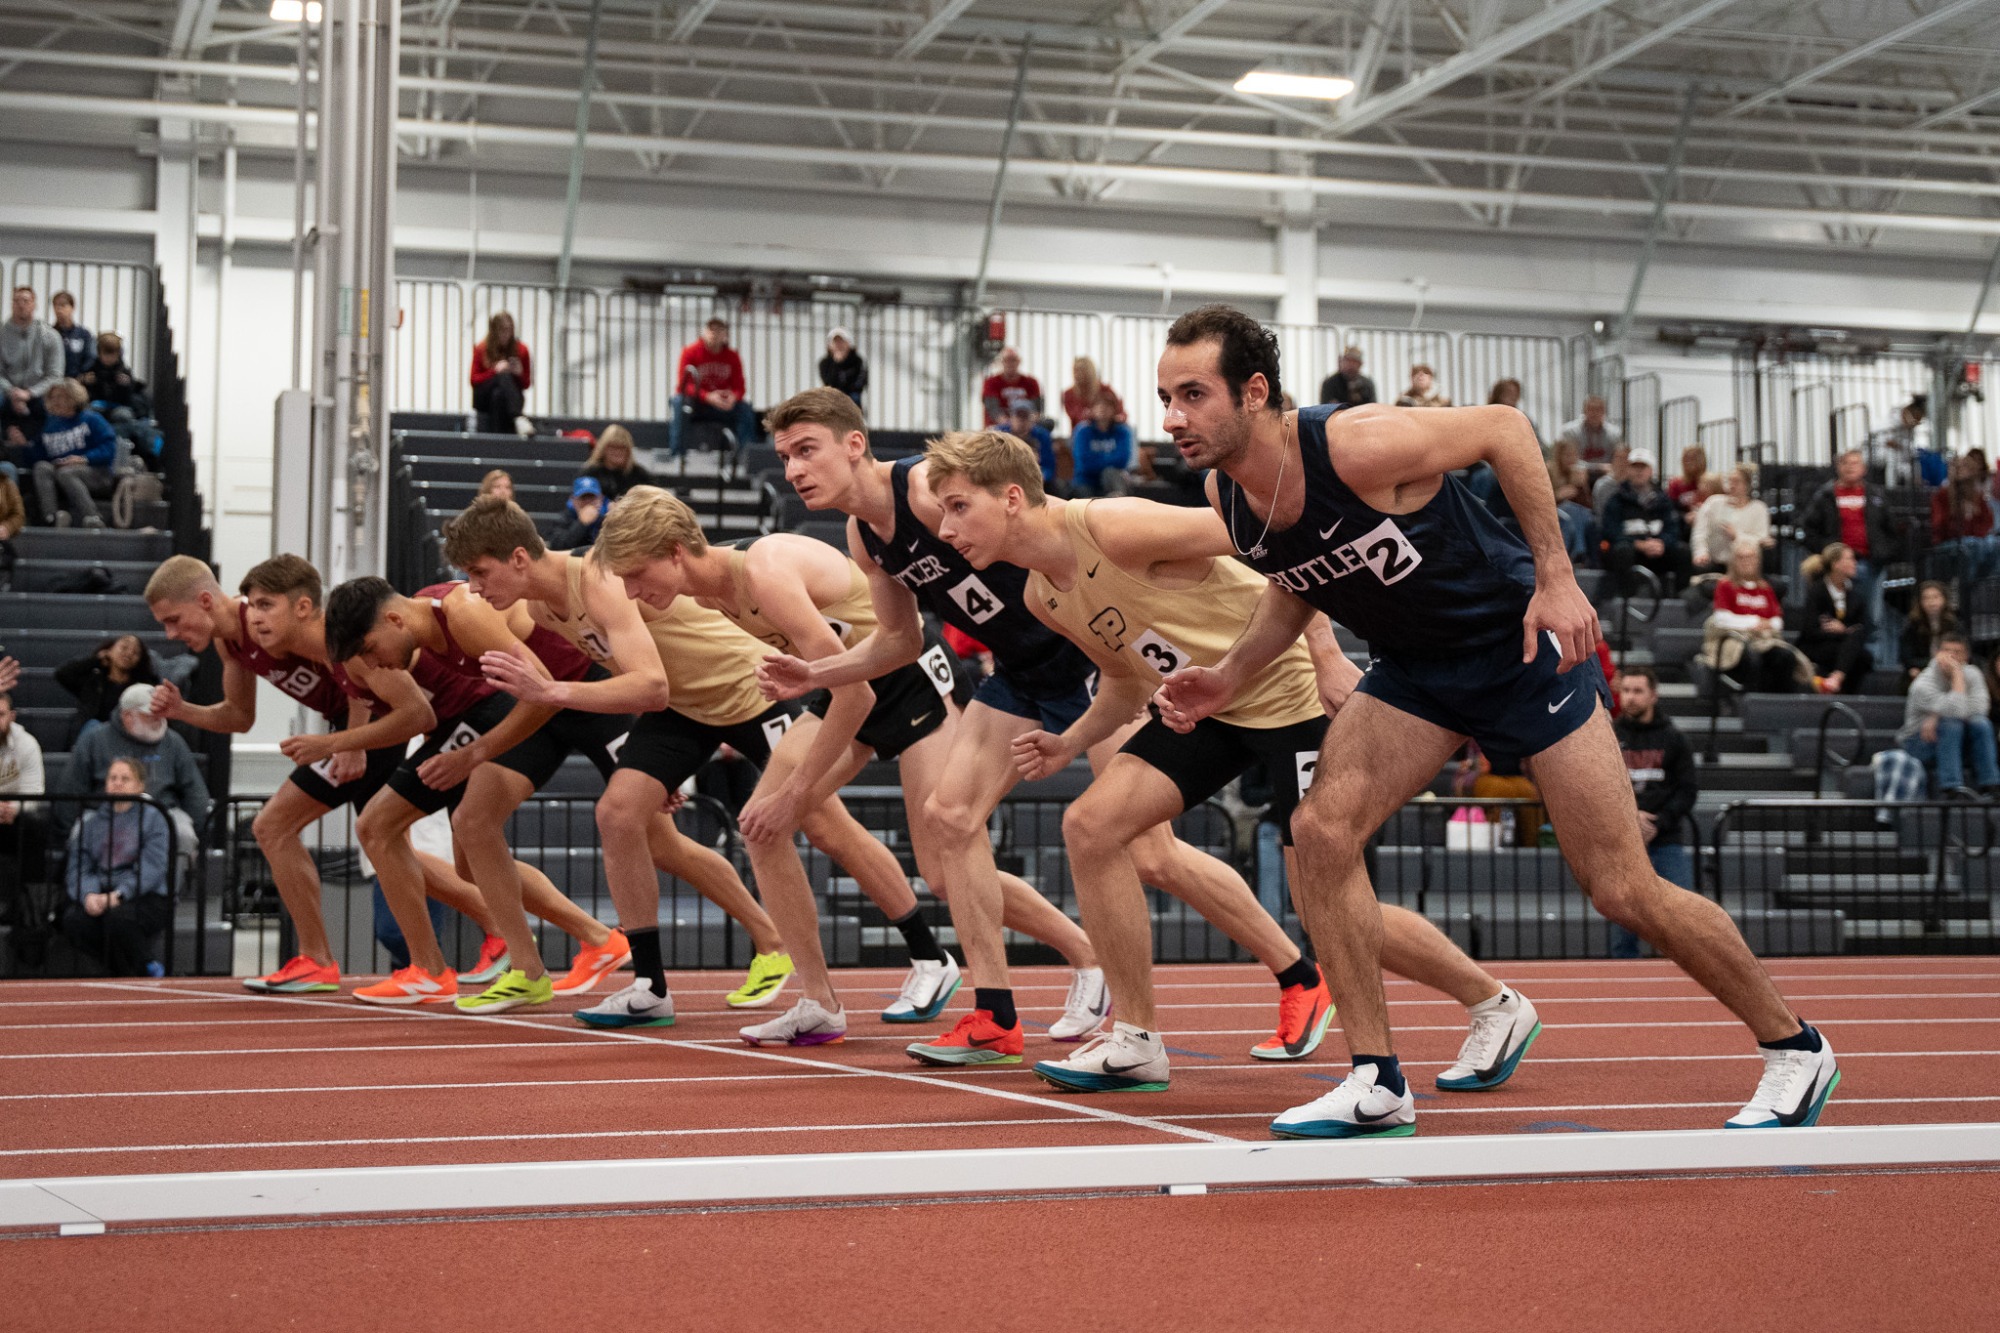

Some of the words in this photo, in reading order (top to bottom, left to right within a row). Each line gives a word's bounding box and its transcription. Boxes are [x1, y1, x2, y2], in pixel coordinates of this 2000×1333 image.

[1264, 543, 1367, 593] BUTLE
[1366, 537, 1414, 581] 2
[965, 586, 994, 617] 4
[583, 633, 608, 653] 7
[1088, 606, 1126, 652] P
[928, 653, 951, 684] 6
[1141, 643, 1178, 673] 3
[287, 671, 313, 693] 10
